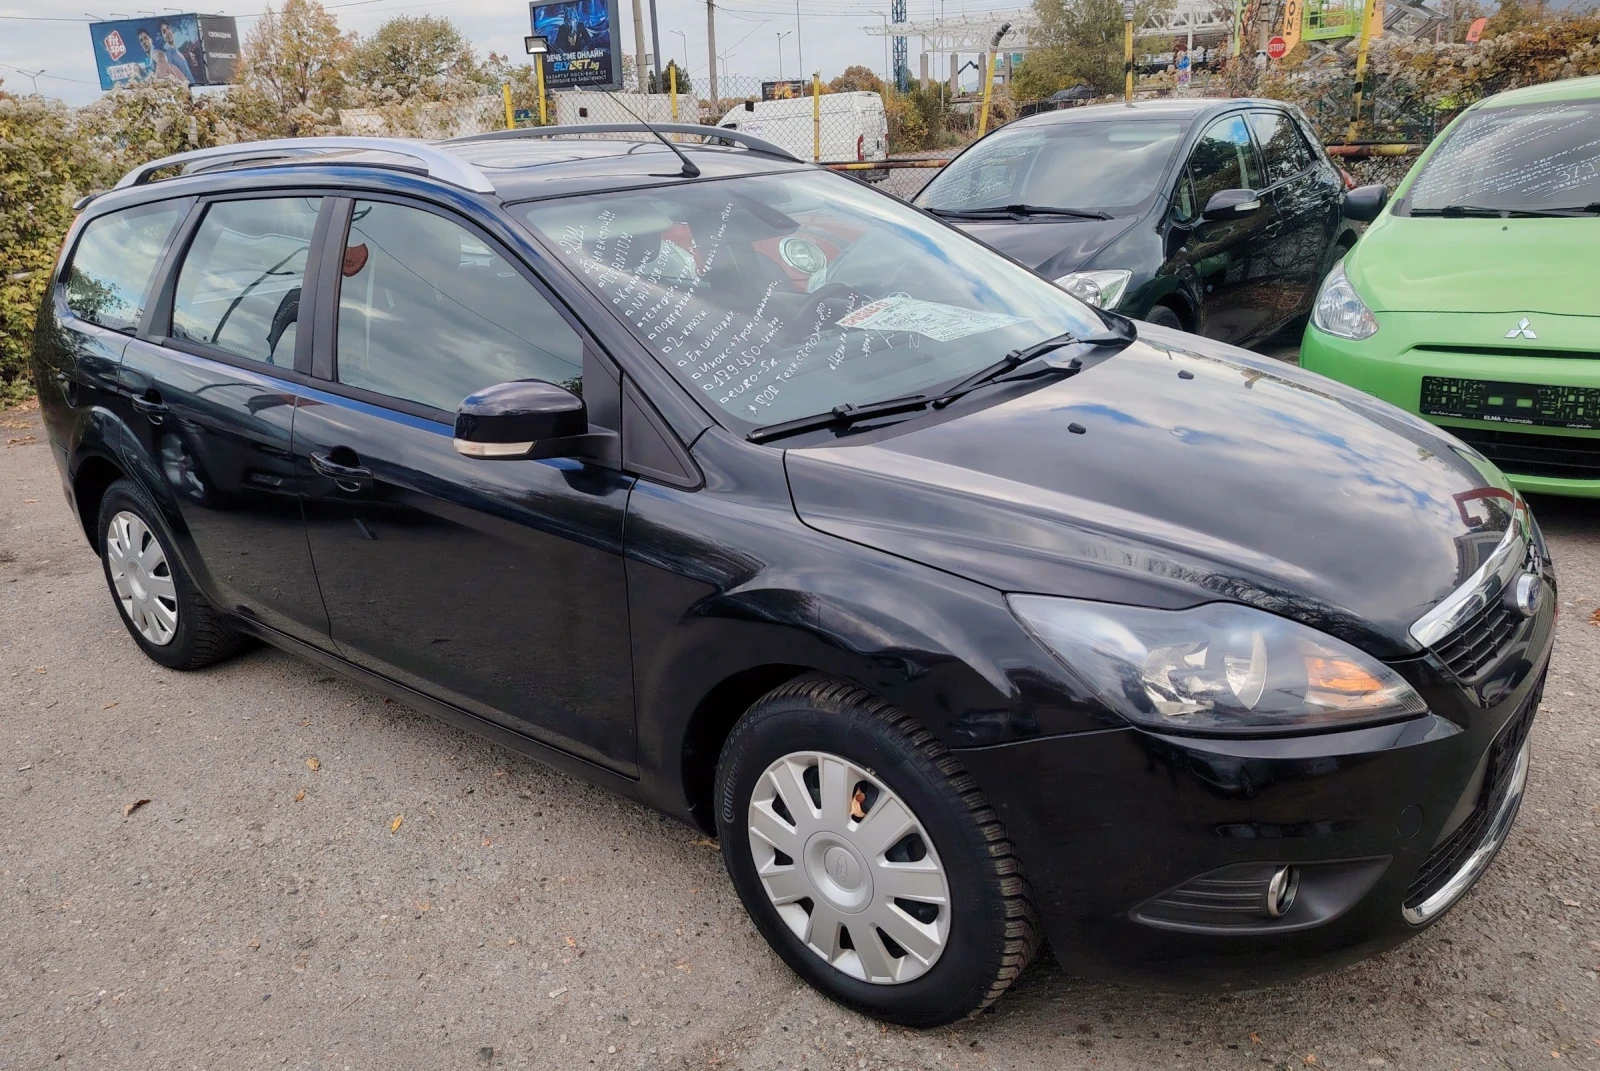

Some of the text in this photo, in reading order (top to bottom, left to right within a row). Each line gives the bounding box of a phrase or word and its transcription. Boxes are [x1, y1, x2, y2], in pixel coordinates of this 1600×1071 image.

[1269, 43, 1285, 53] STOP
[577, 49, 604, 60] ОНЛАЙН
[553, 59, 600, 72] SLYBET.bg
[755, 384, 780, 407] ТОП
[1483, 414, 1533, 425] ELMA Automobile
